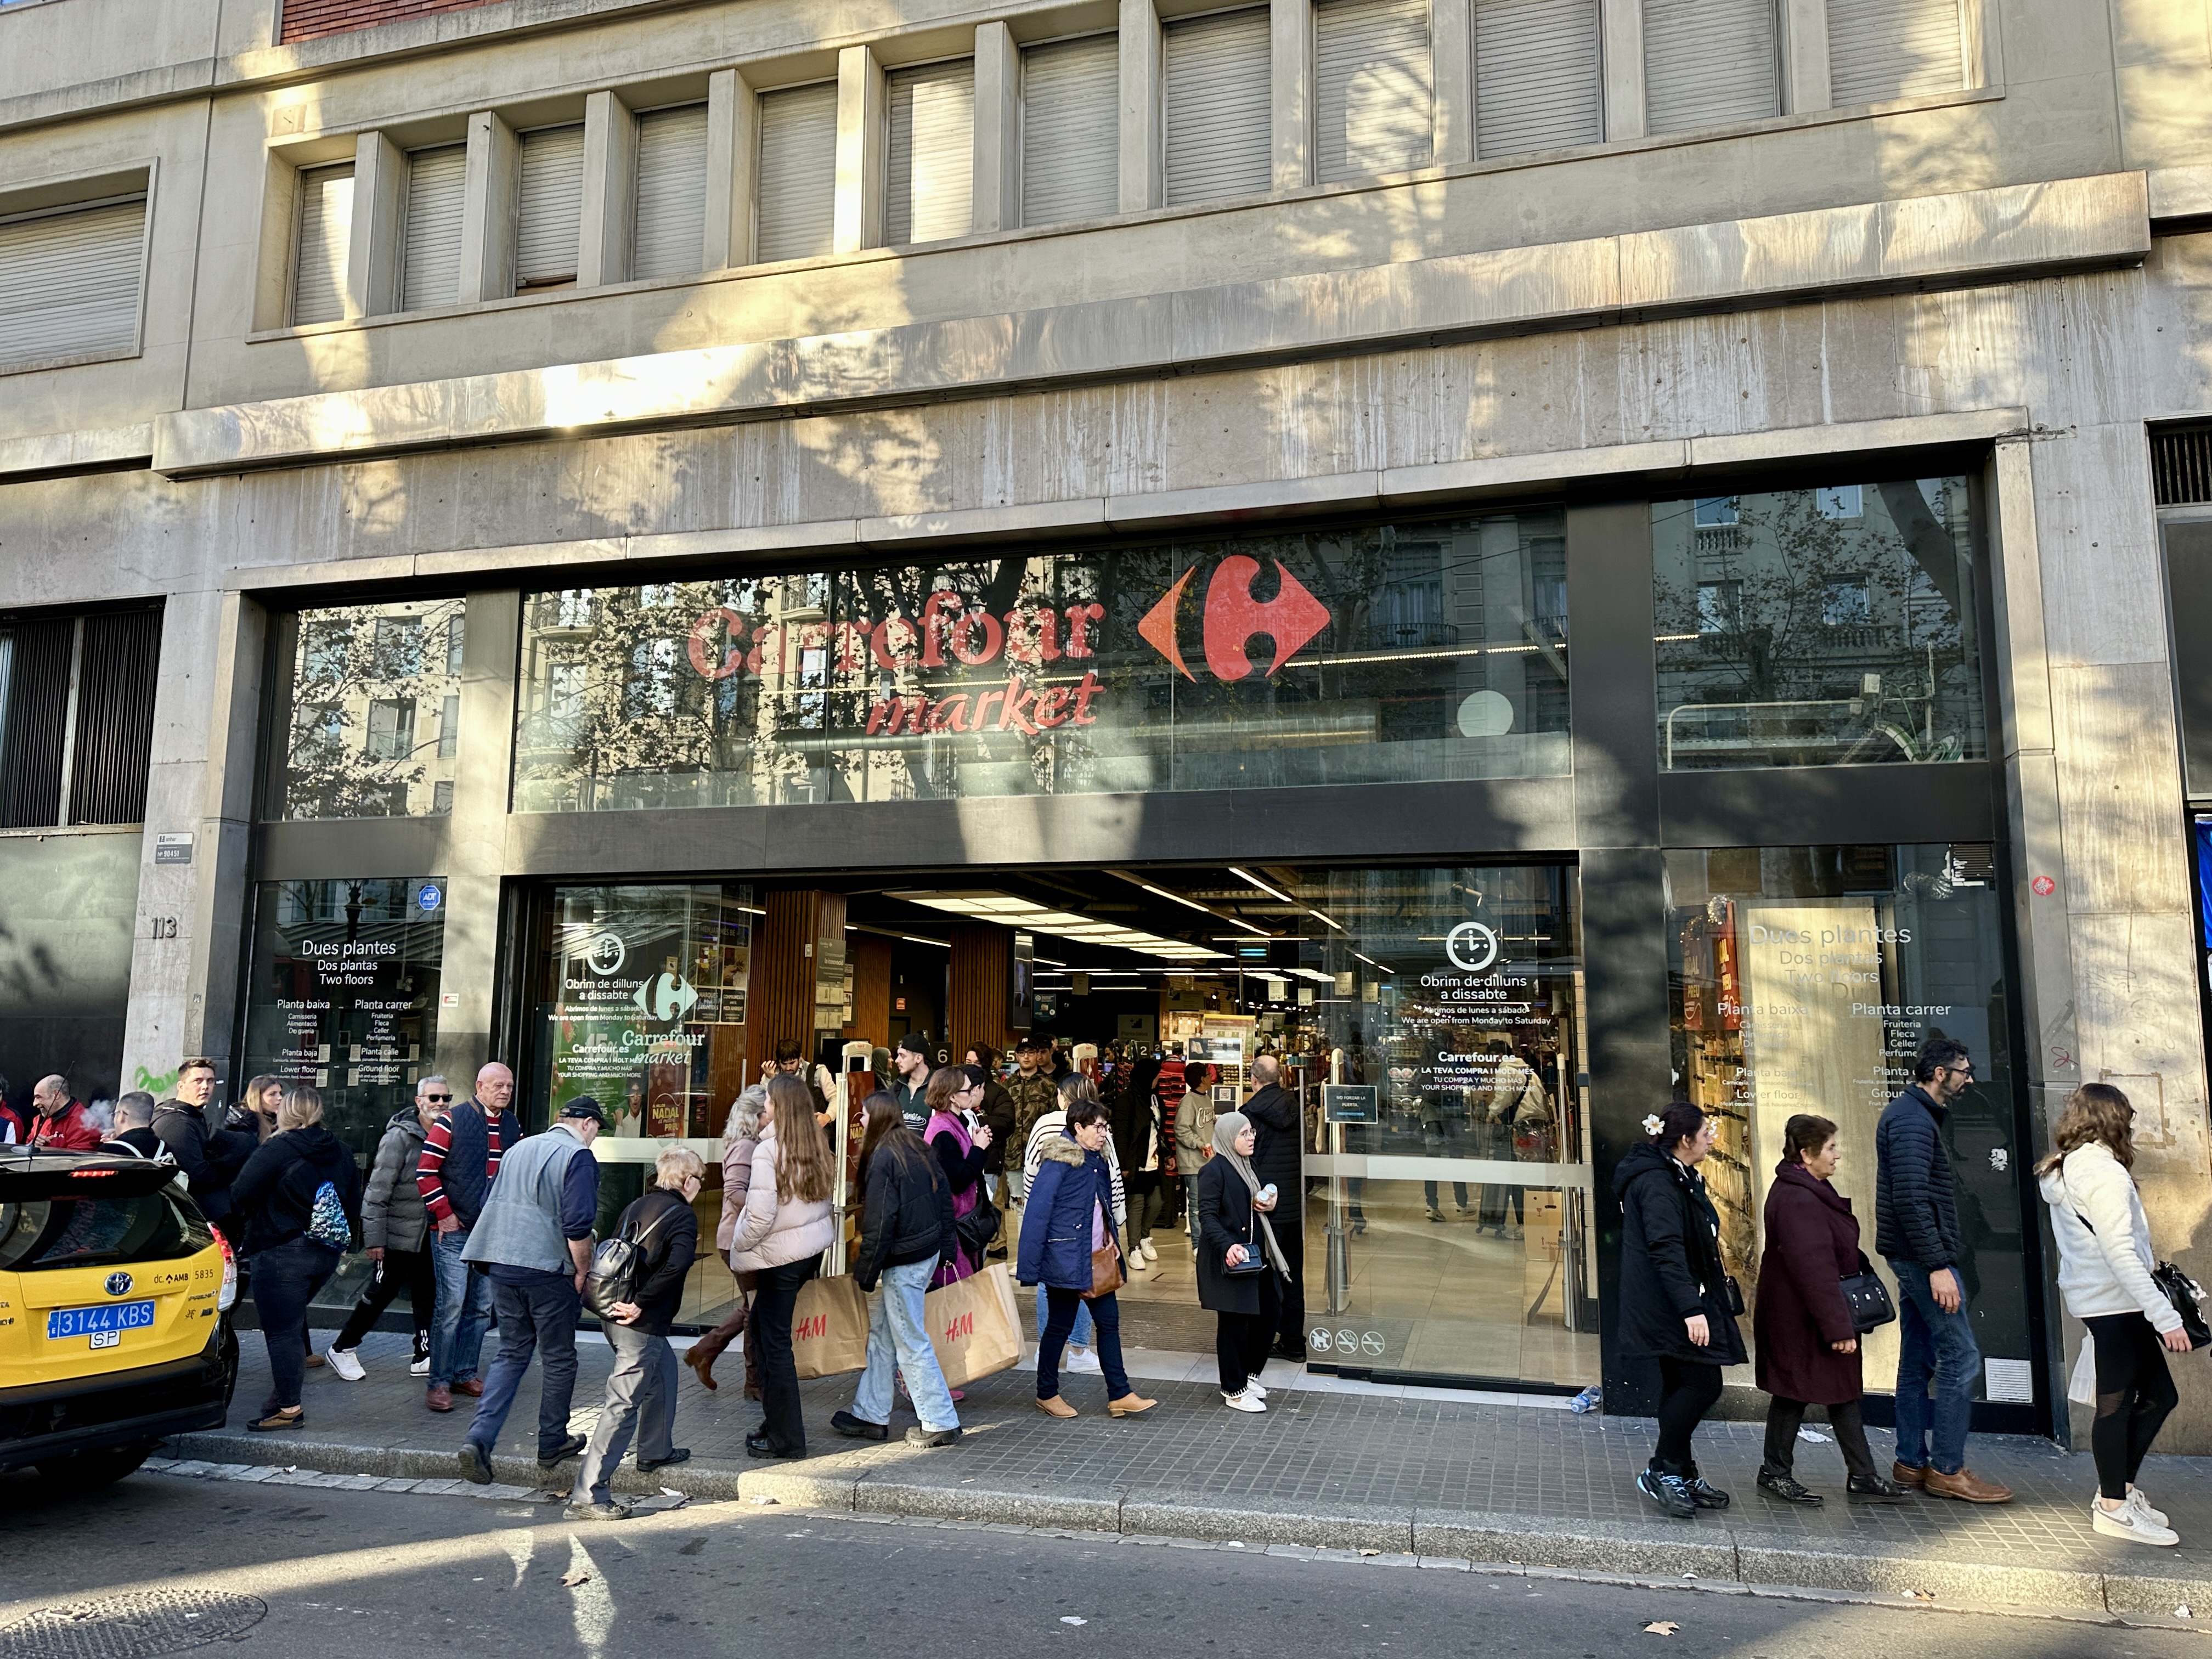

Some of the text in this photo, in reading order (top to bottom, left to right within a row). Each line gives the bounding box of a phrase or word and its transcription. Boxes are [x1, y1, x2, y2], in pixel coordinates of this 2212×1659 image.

[689, 590, 1104, 679] Carrefour
[866, 673, 1104, 736] market
[423, 892, 437, 901] ADT
[152, 916, 177, 939] 113
[1750, 925, 1911, 947] Dues plantes
[302, 940, 396, 958] Dues plantes
[1780, 951, 1883, 966] Dos plantas
[318, 960, 377, 973] Dos plantas
[319, 974, 374, 985] Two floors
[1420, 975, 1527, 986] Obrim de dilluns
[1785, 969, 1878, 983] Two floors
[565, 979, 644, 989] Obrim de dilluns
[579, 990, 628, 1000] a dissabte
[1441, 989, 1507, 1000] a dissabte
[277, 999, 330, 1009] Planta baixa
[355, 999, 383, 1009] Planta
[1717, 1003, 1808, 1015] Planta baixa
[1852, 1002, 1951, 1015] Planta carrer
[1472, 1017, 1502, 1026] Monday
[1515, 1017, 1551, 1026] Saturday
[1883, 1020, 1921, 1028] Fruiteria
[622, 1029, 705, 1046] Carrefour
[1891, 1030, 1915, 1038] Fleca
[572, 1044, 629, 1053] Carrefour.es
[1891, 1039, 1917, 1047] Celler
[304, 1049, 318, 1058] baja
[937, 1049, 948, 1063] 6
[1006, 1051, 1015, 1062] 5
[1140, 1046, 1147, 1056] 2
[1878, 1048, 1917, 1057] Perfume
[634, 1050, 692, 1066] market
[1438, 1052, 1515, 1063] Carrefour.es
[1519, 1066, 1534, 1075] MÉS
[1736, 1067, 1770, 1077] Planta
[1873, 1066, 1909, 1076] Planta
[1737, 1089, 1799, 1099] Lower floor
[652, 1107, 679, 1120] NADAL
[664, 1123, 679, 1131] PREU
[850, 1127, 864, 1139] NAD
[174, 1273, 188, 1282] AMB
[195, 1269, 213, 1279] 5835
[61, 1304, 150, 1333] 3144 KBS
[795, 1314, 826, 1341] H&M
[945, 1311, 973, 1343] H&M
[94, 1331, 117, 1346] SP
